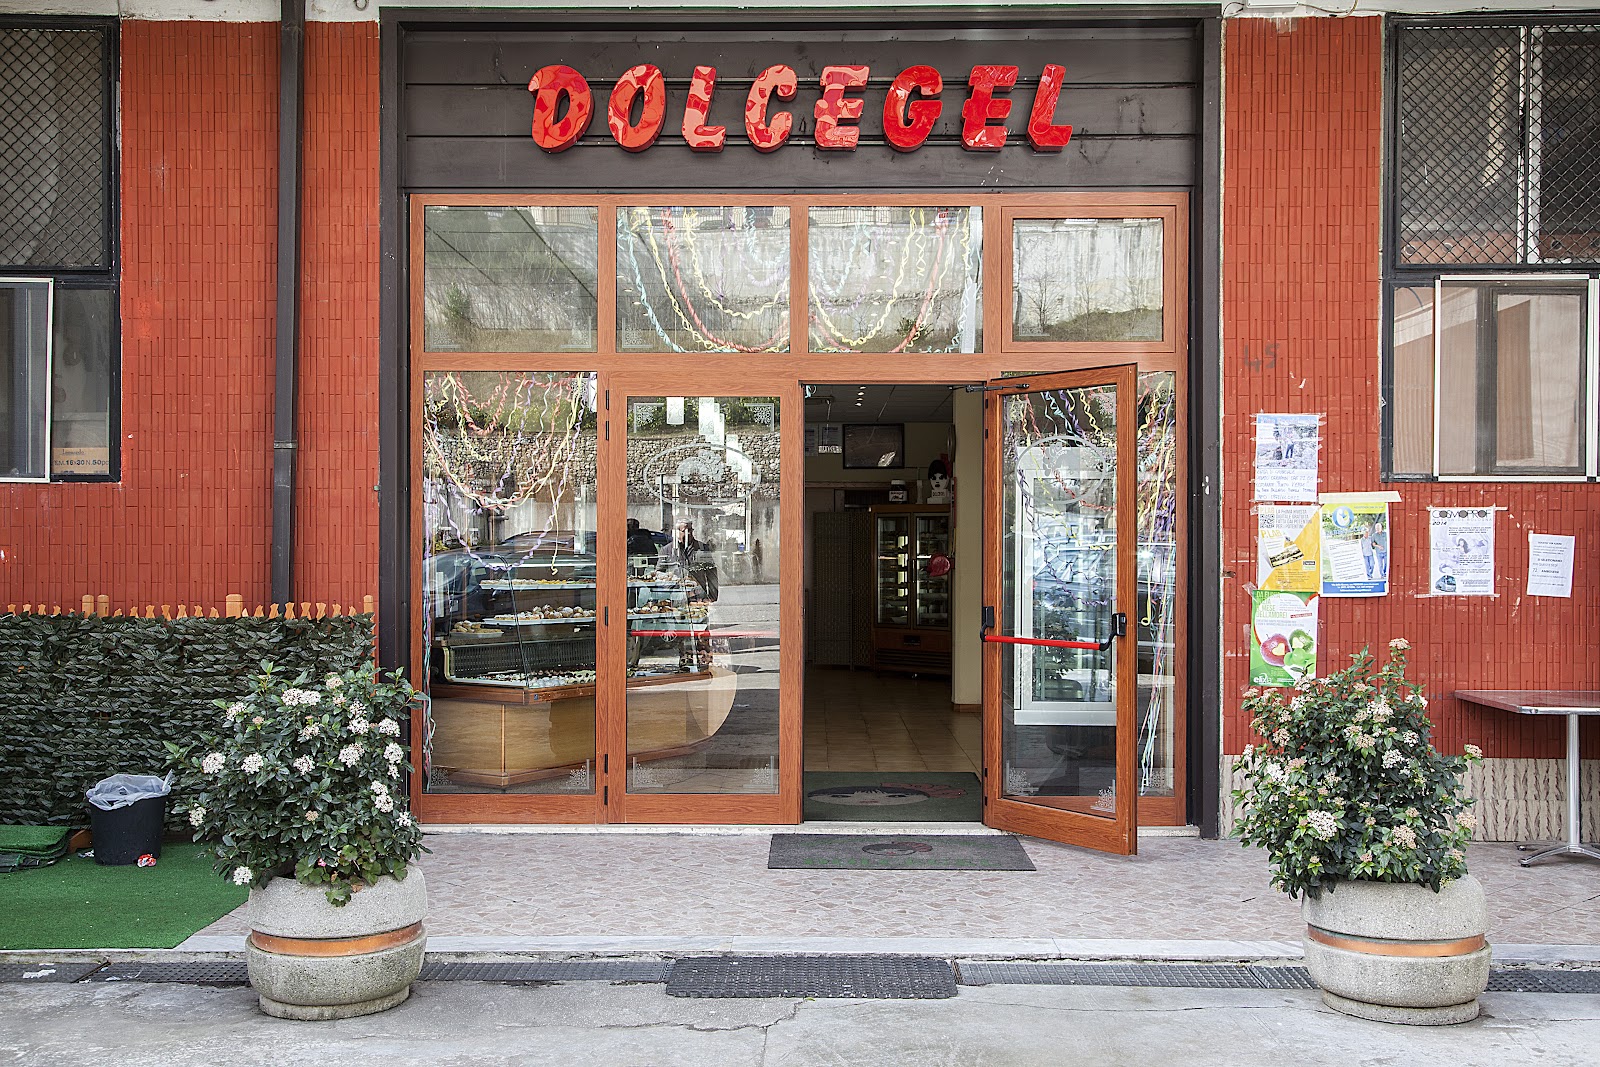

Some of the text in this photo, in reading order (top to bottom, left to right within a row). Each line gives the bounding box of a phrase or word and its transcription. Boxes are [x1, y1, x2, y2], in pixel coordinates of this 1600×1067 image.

[528, 63, 1075, 153] DOLCEGEL
[1243, 342, 1280, 374] 45
[1432, 509, 1491, 518] COSMOPROF
[1260, 529, 1282, 538] P.LAB
